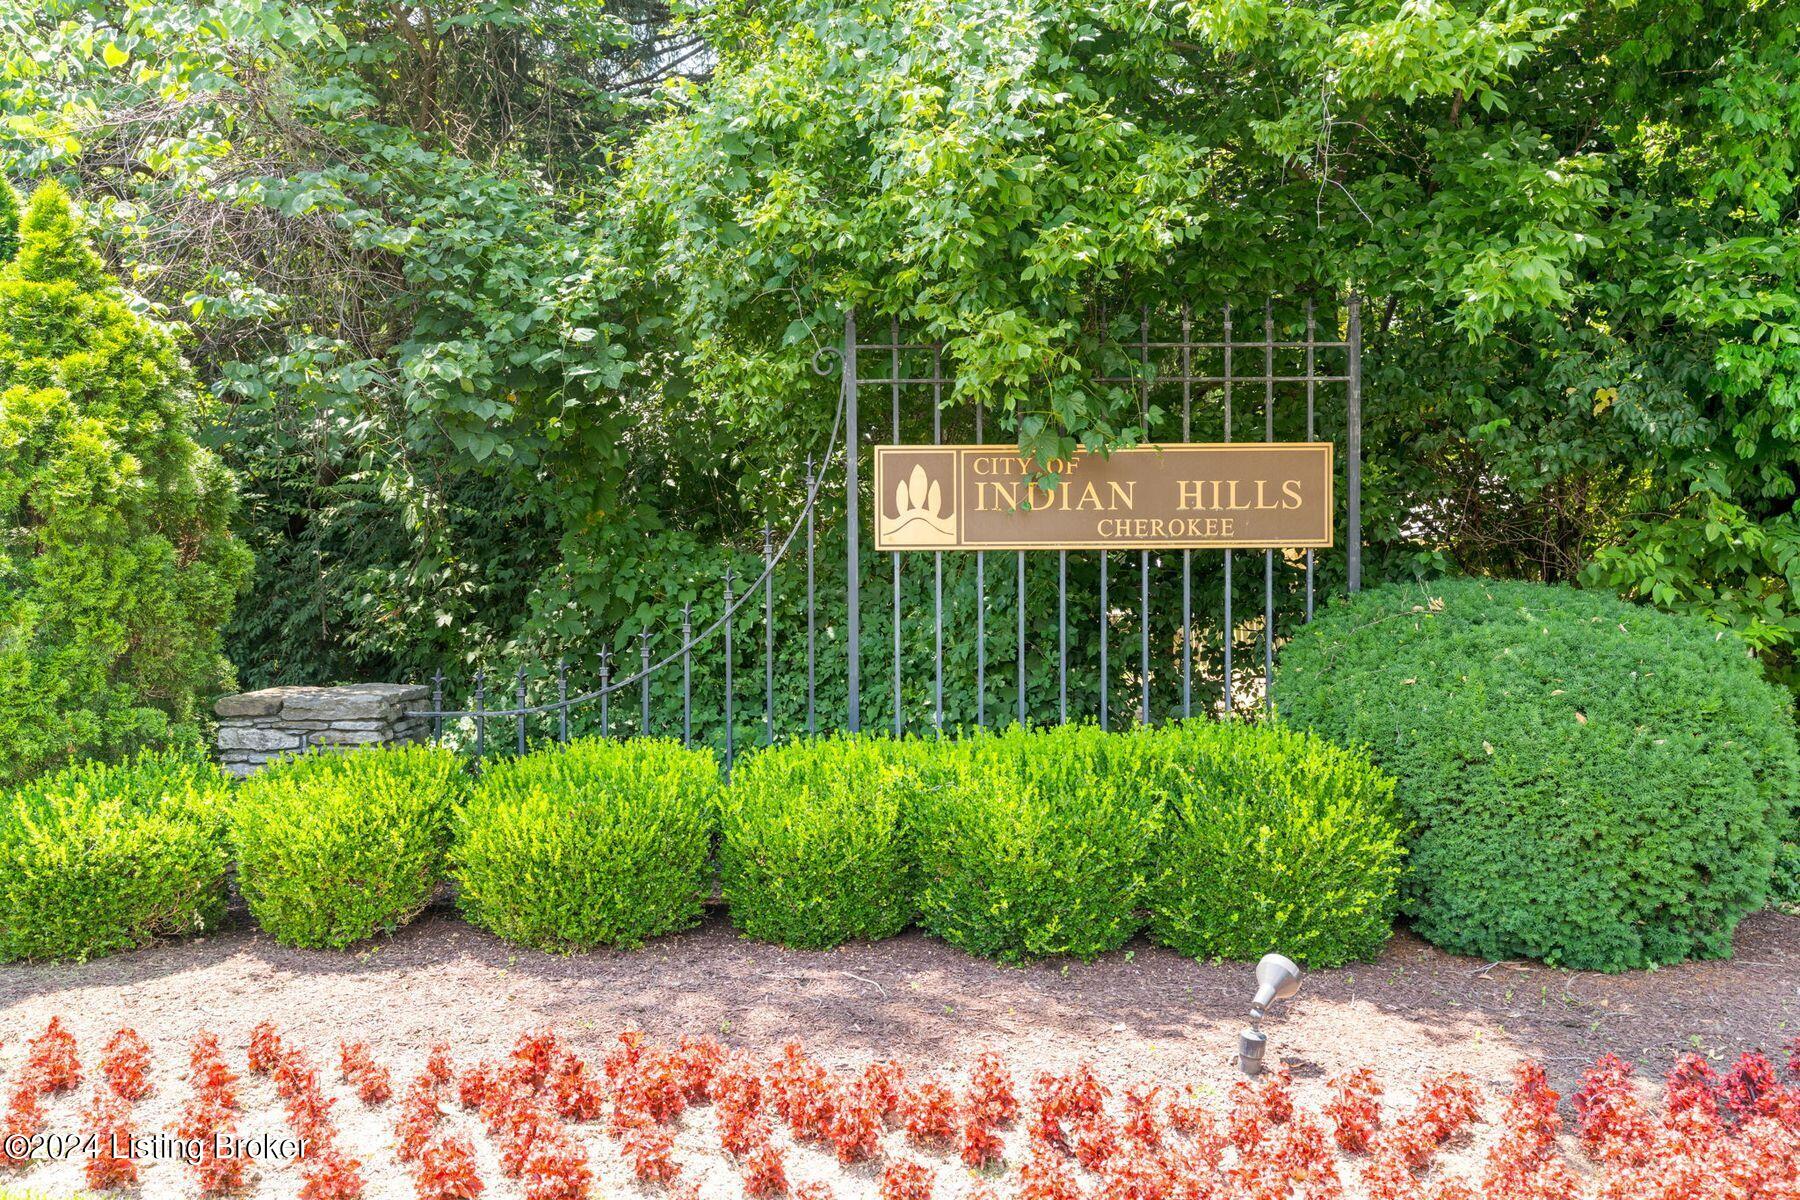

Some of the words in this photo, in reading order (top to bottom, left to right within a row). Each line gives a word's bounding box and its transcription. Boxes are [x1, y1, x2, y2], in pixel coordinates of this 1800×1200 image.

[973, 457, 1032, 475] CITY
[1046, 457, 1080, 475] OF
[974, 480, 1136, 511] INDIAN
[1176, 479, 1303, 511] HILLS
[1097, 518, 1235, 537] CHEROKEE
